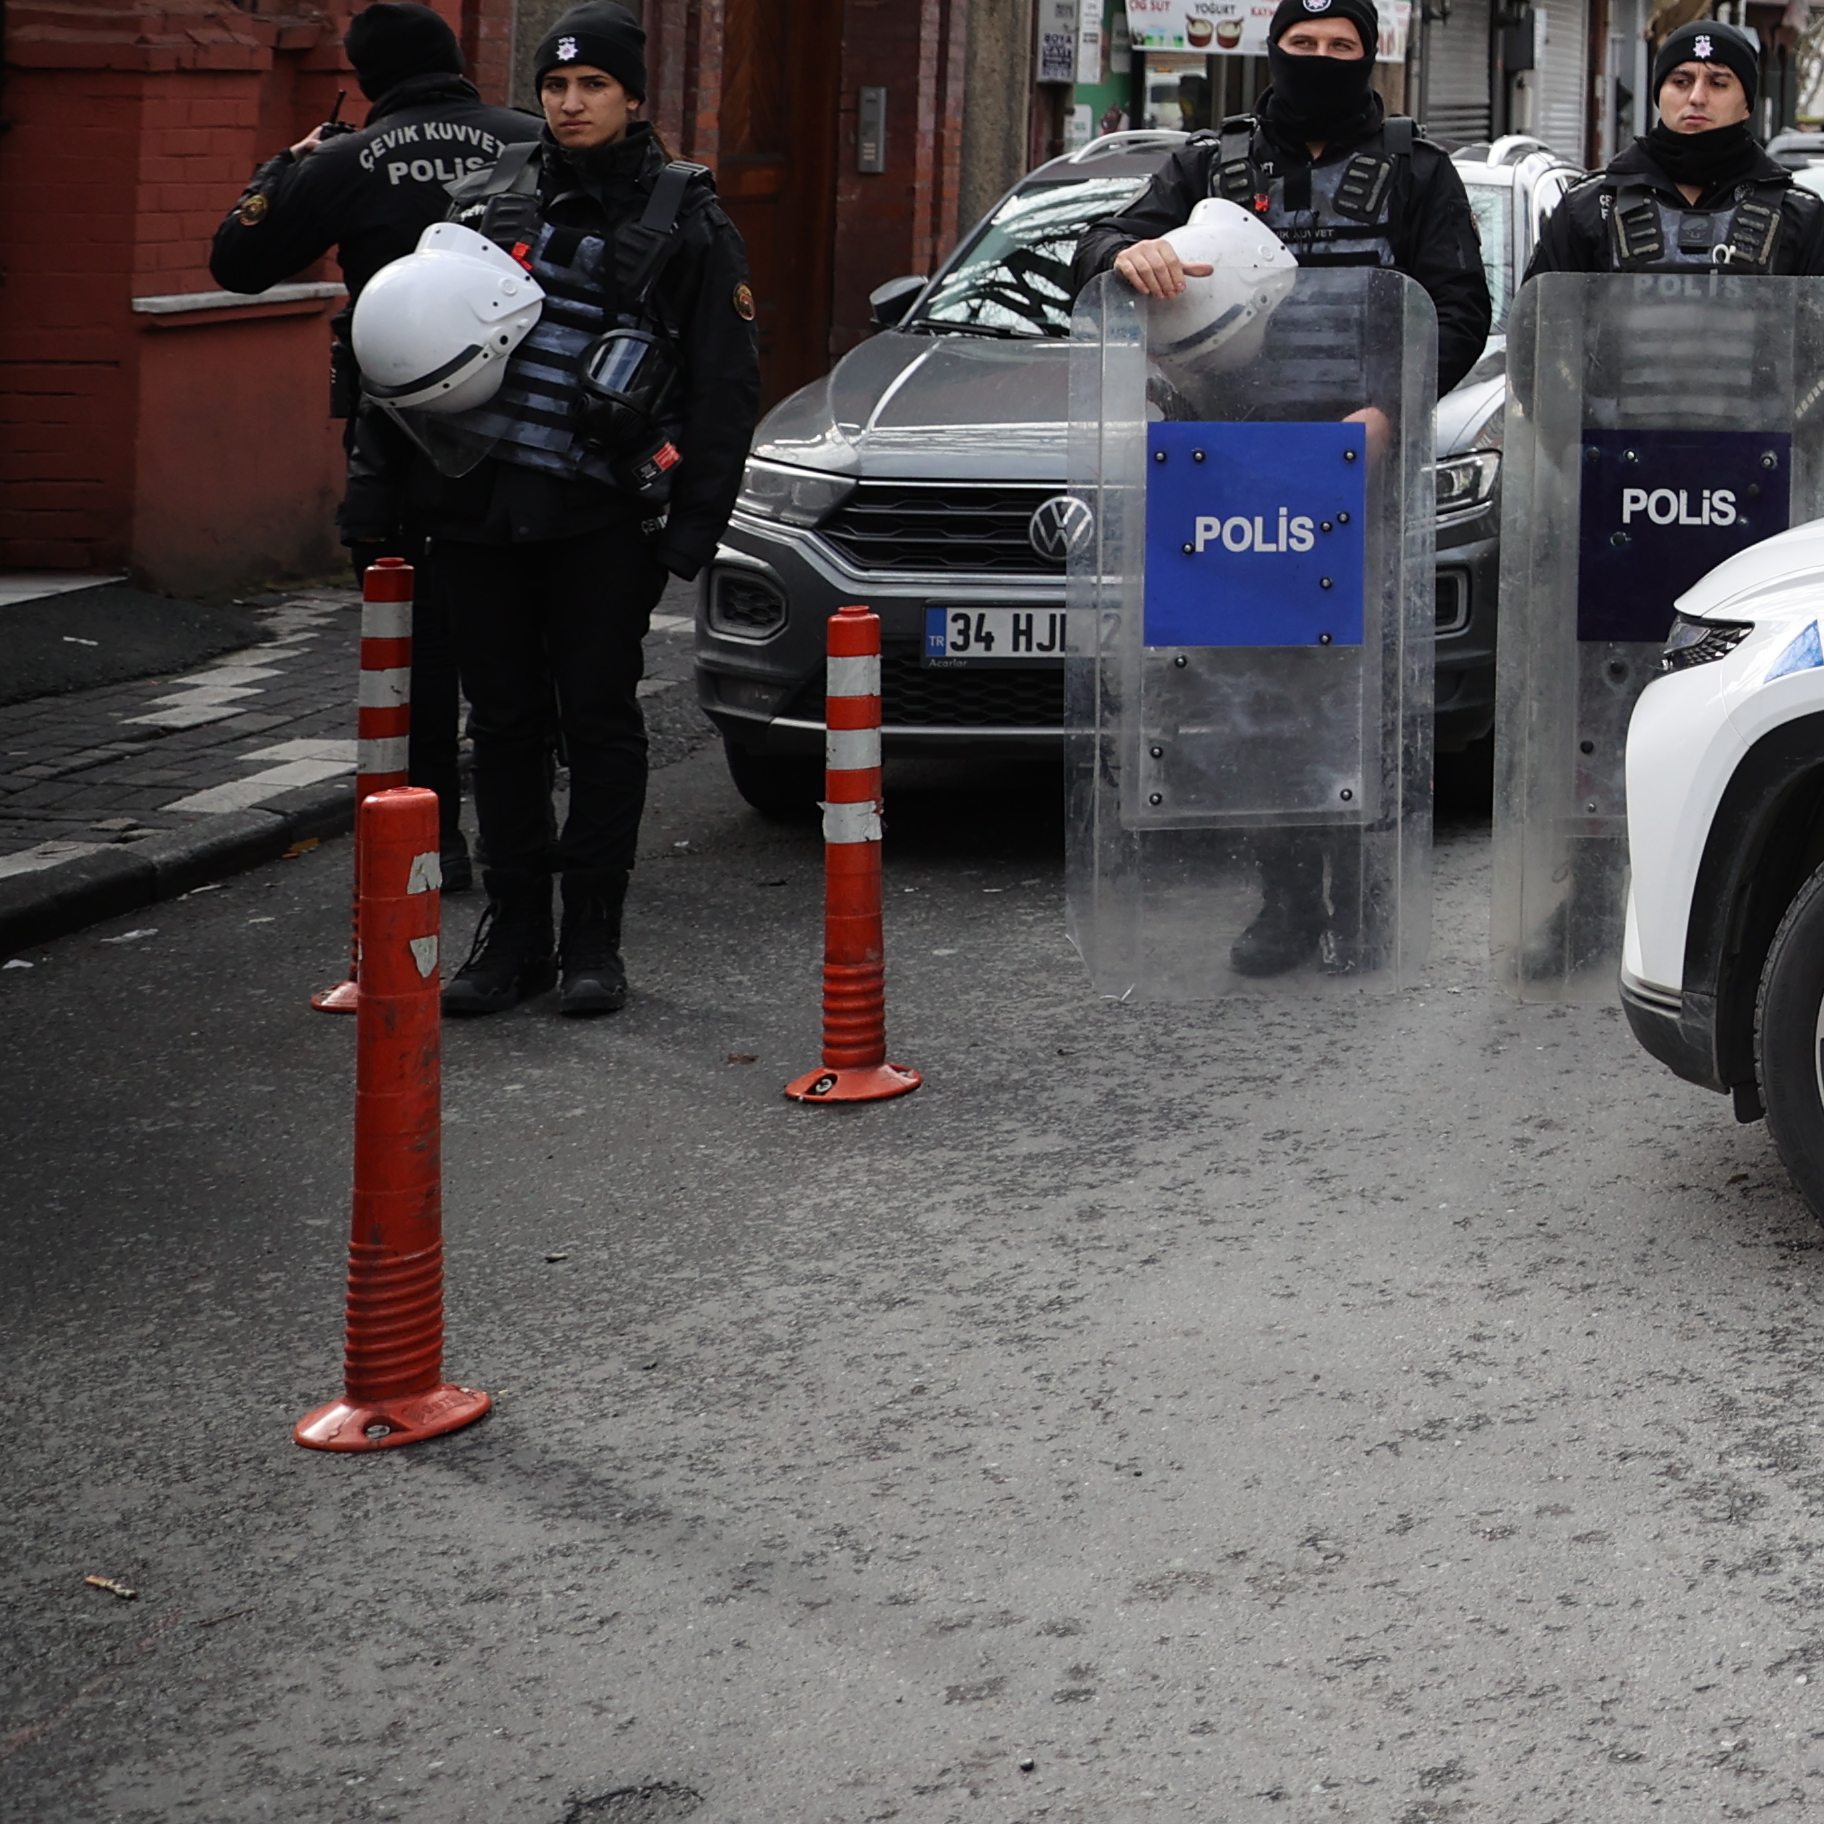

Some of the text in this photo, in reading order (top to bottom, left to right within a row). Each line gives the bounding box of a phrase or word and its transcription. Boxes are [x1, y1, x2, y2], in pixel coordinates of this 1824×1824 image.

[359, 122, 507, 172] ÇEVİK KUVVET
[1622, 488, 1737, 526] POLİS
[1195, 506, 1315, 553] POLİS
[928, 635, 945, 648] TR
[950, 612, 995, 652] 34
[928, 658, 969, 669] Acarlar
